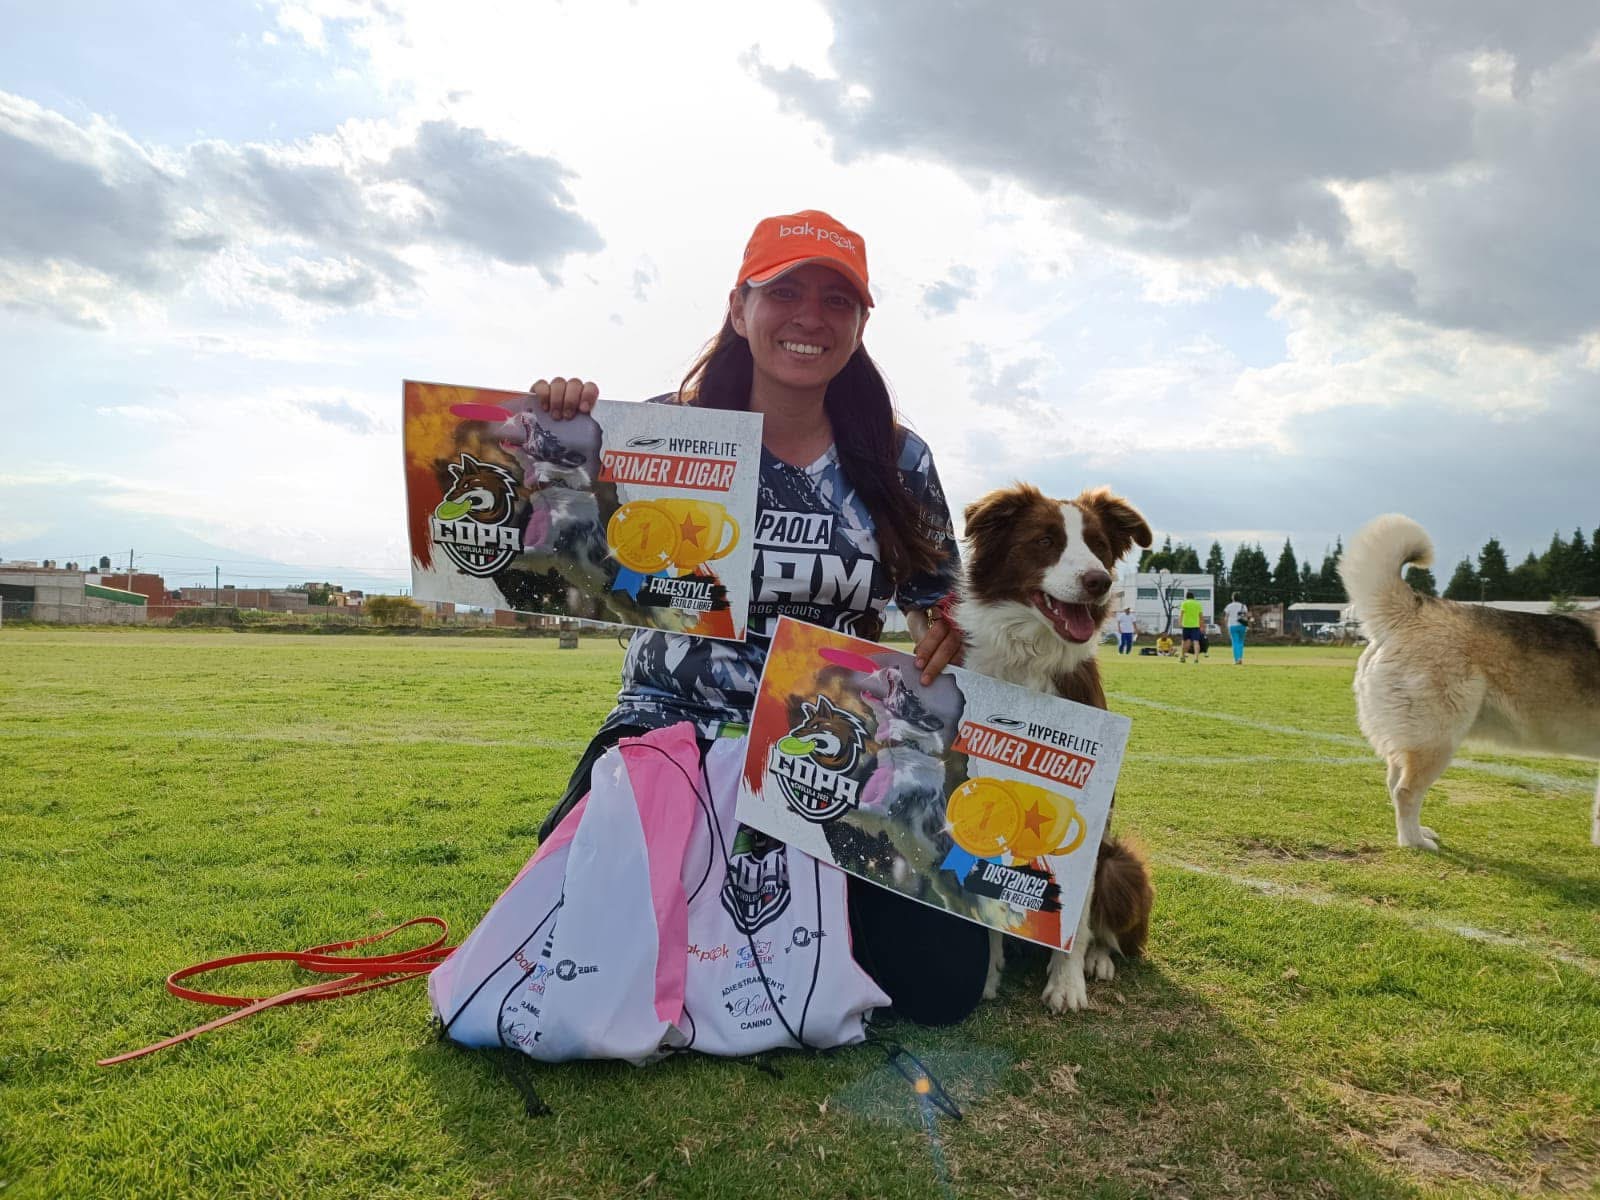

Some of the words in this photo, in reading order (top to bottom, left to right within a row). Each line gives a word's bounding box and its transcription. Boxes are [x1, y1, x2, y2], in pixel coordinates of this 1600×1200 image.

[780, 222, 815, 237] bak
[669, 438, 738, 457] HYPERFLITE
[602, 454, 671, 483] PRIMER
[674, 460, 735, 489] LUGAR
[433, 519, 520, 551] COPA
[755, 513, 829, 545] PAOLA
[649, 577, 714, 600] FREESTYLE
[750, 549, 874, 611] AM
[749, 604, 773, 614] DOG
[776, 604, 821, 620] SCOUTS
[956, 724, 1028, 767] PRIMER
[1027, 748, 1092, 786] LUGAR
[1028, 722, 1099, 757] HYPERFLITE
[770, 748, 859, 806] COPA
[740, 1017, 773, 1030] CANINO
